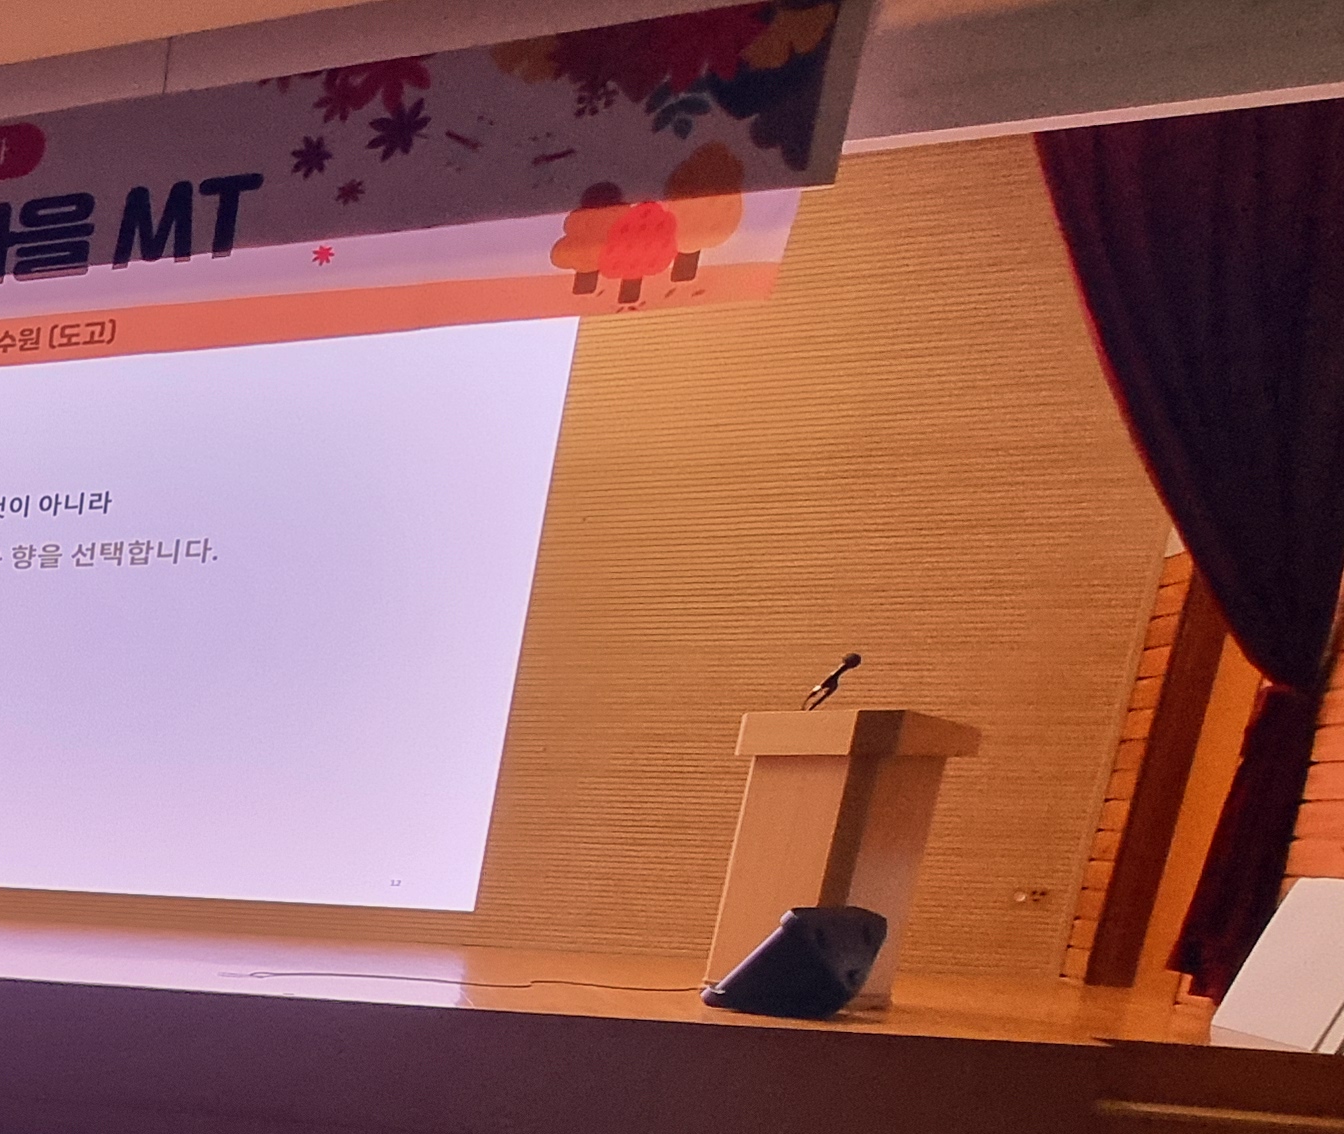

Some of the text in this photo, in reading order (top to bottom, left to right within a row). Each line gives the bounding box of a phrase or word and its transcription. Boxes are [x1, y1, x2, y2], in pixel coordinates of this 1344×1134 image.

[112, 173, 264, 270] MT
[48, 318, 117, 349] (도고)
[38, 490, 113, 517] 아니라
[11, 543, 63, 570] 향을
[70, 537, 219, 568] 선택합니다.
